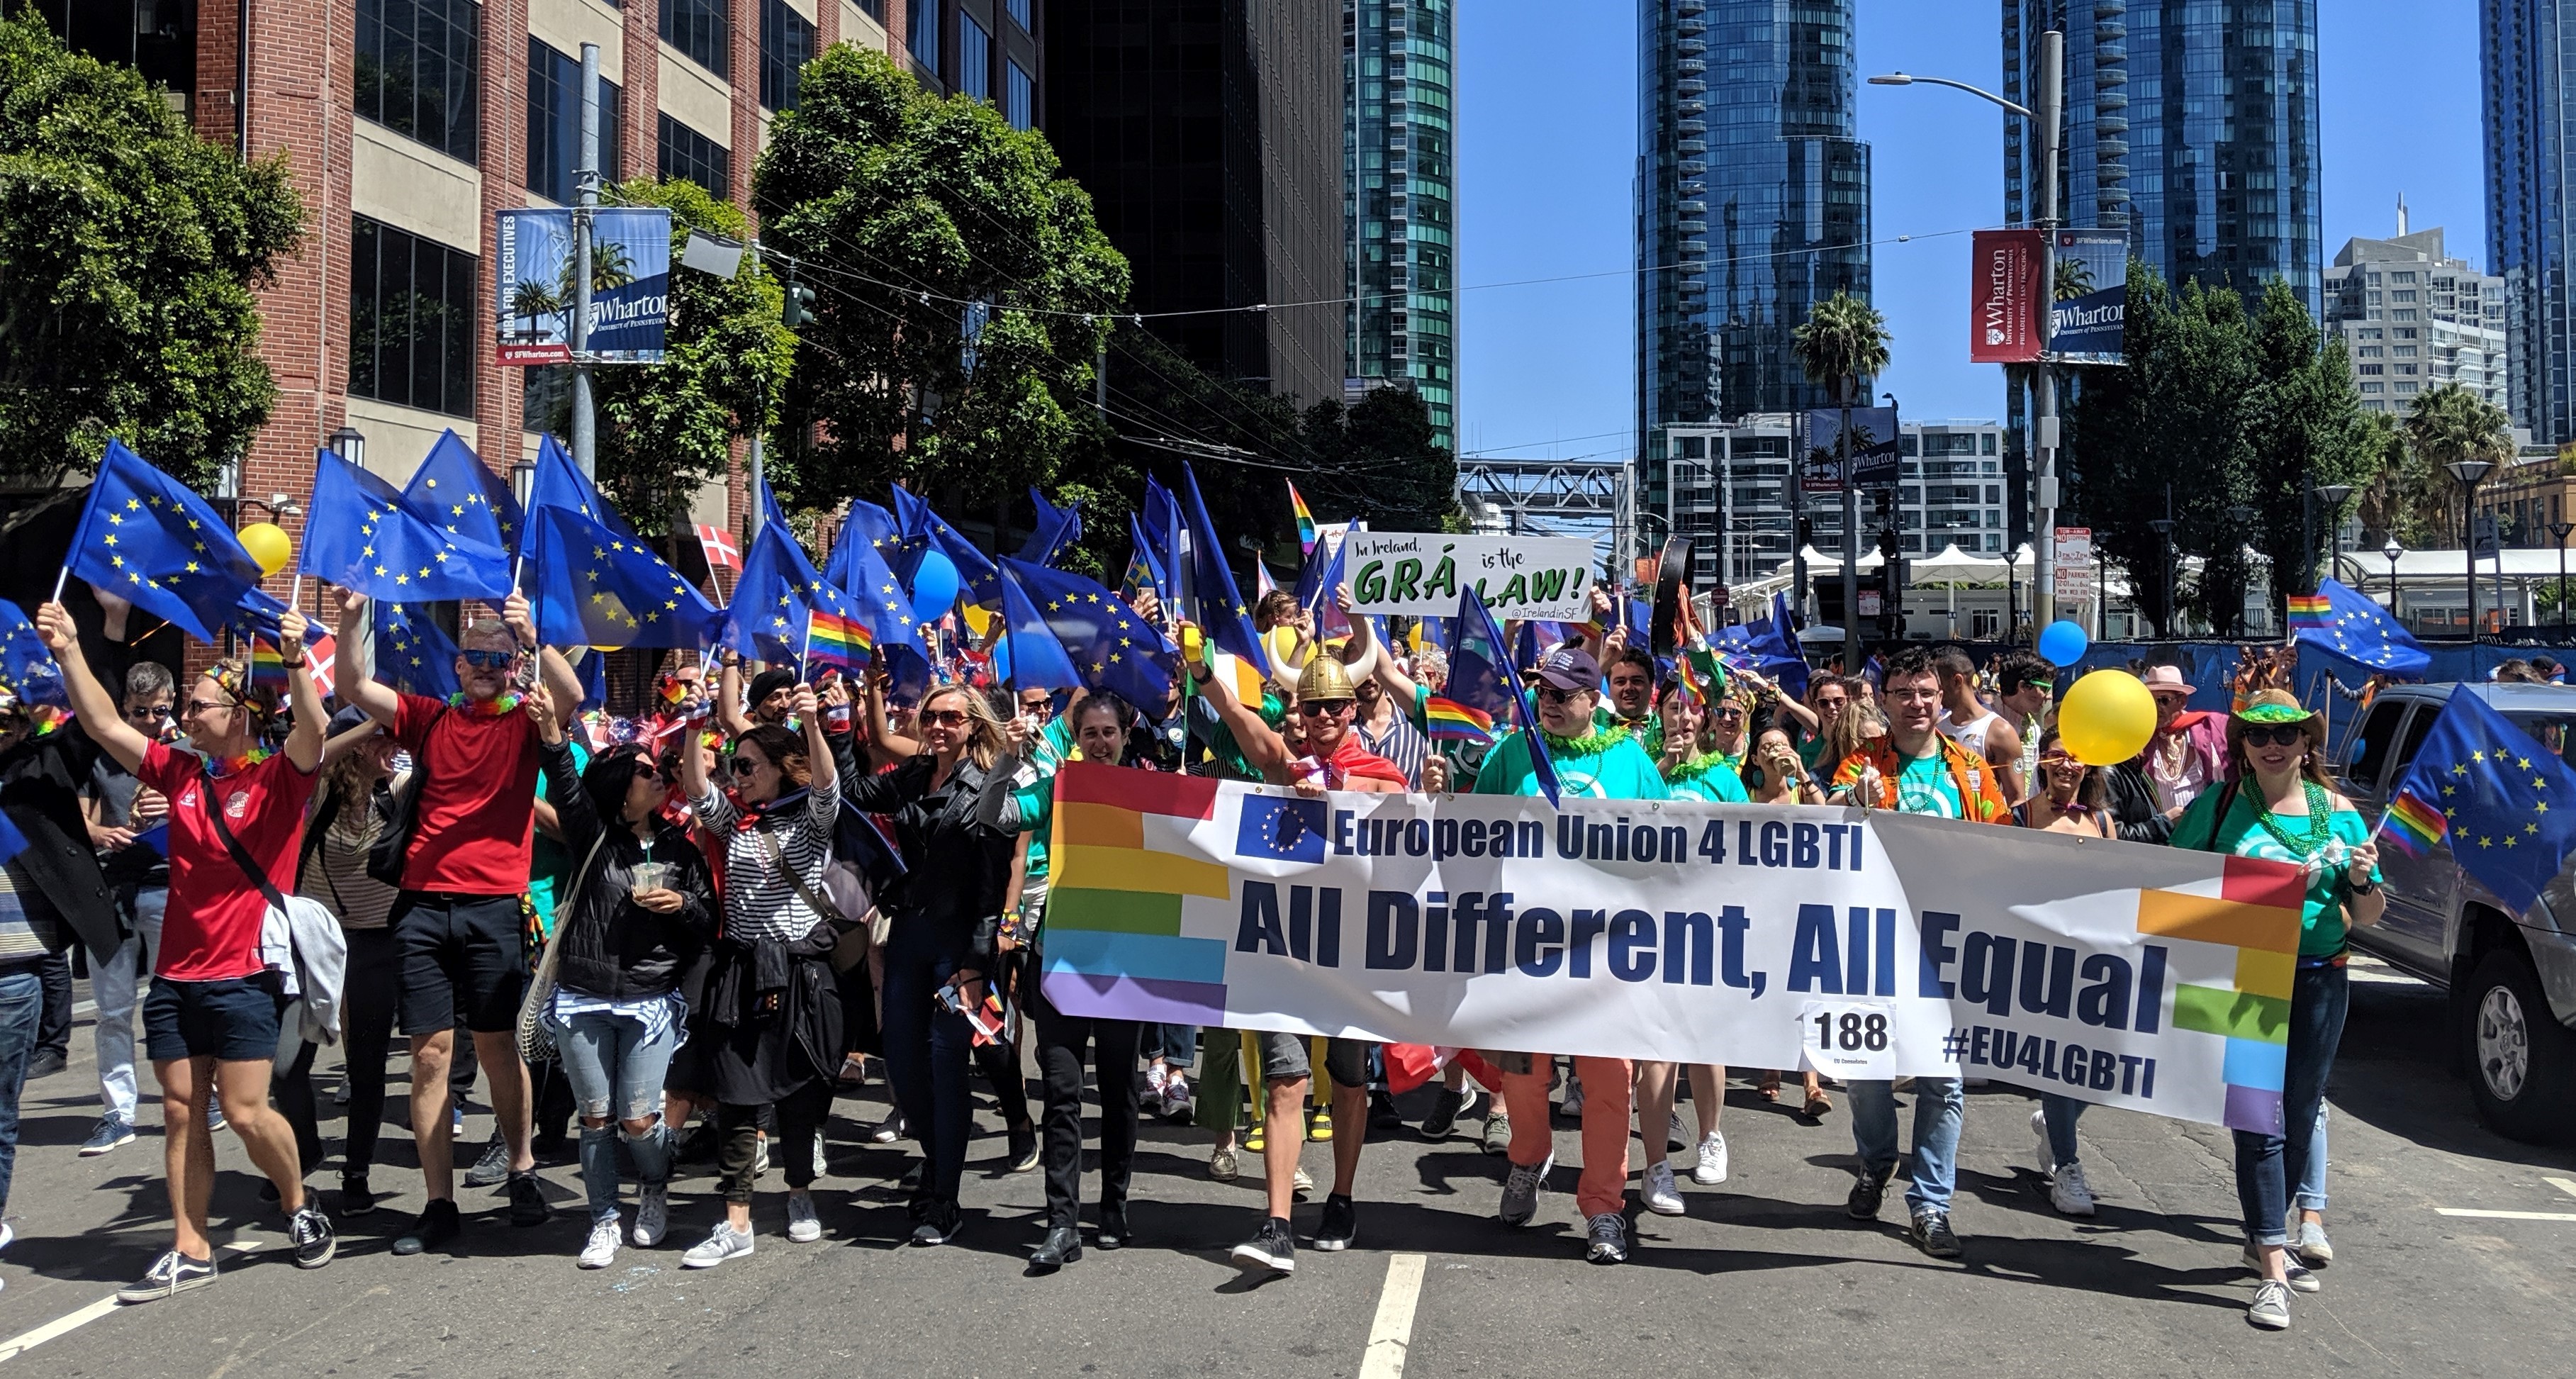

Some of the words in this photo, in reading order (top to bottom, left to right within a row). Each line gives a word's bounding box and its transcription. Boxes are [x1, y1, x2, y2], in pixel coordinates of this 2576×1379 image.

[503, 216, 515, 284] EXECUTIVES
[503, 286, 515, 310] FOR
[1986, 248, 2005, 328] Wharton
[2007, 297, 2014, 306] of
[503, 313, 515, 338] MBA
[598, 323, 622, 332] UNIVERSITY
[623, 320, 629, 330] of
[2083, 327, 2090, 335] of
[514, 350, 564, 359] SFWharton.com
[1355, 541, 1368, 558] In
[1372, 537, 1422, 557] Ireland,
[2056, 534, 2066, 542] NO
[1482, 553, 1495, 569] is
[1499, 547, 1525, 570] the
[1354, 542, 1457, 605] GRÁ
[2056, 569, 2066, 579] NO
[1474, 566, 1586, 608] LAW!
[1511, 607, 1579, 620] @IrelandinSF
[1333, 809, 1544, 861] European
[1557, 815, 1687, 864] Union
[1698, 820, 1726, 864] 4
[1738, 820, 1863, 871] LGBTI
[1234, 879, 1342, 968] All
[1365, 890, 1766, 1000] Different,
[1786, 903, 1896, 997] All
[1918, 910, 2168, 1035] Equal
[1814, 1012, 1888, 1051] 188
[1942, 1025, 2157, 1100] #EU4LGBTI
